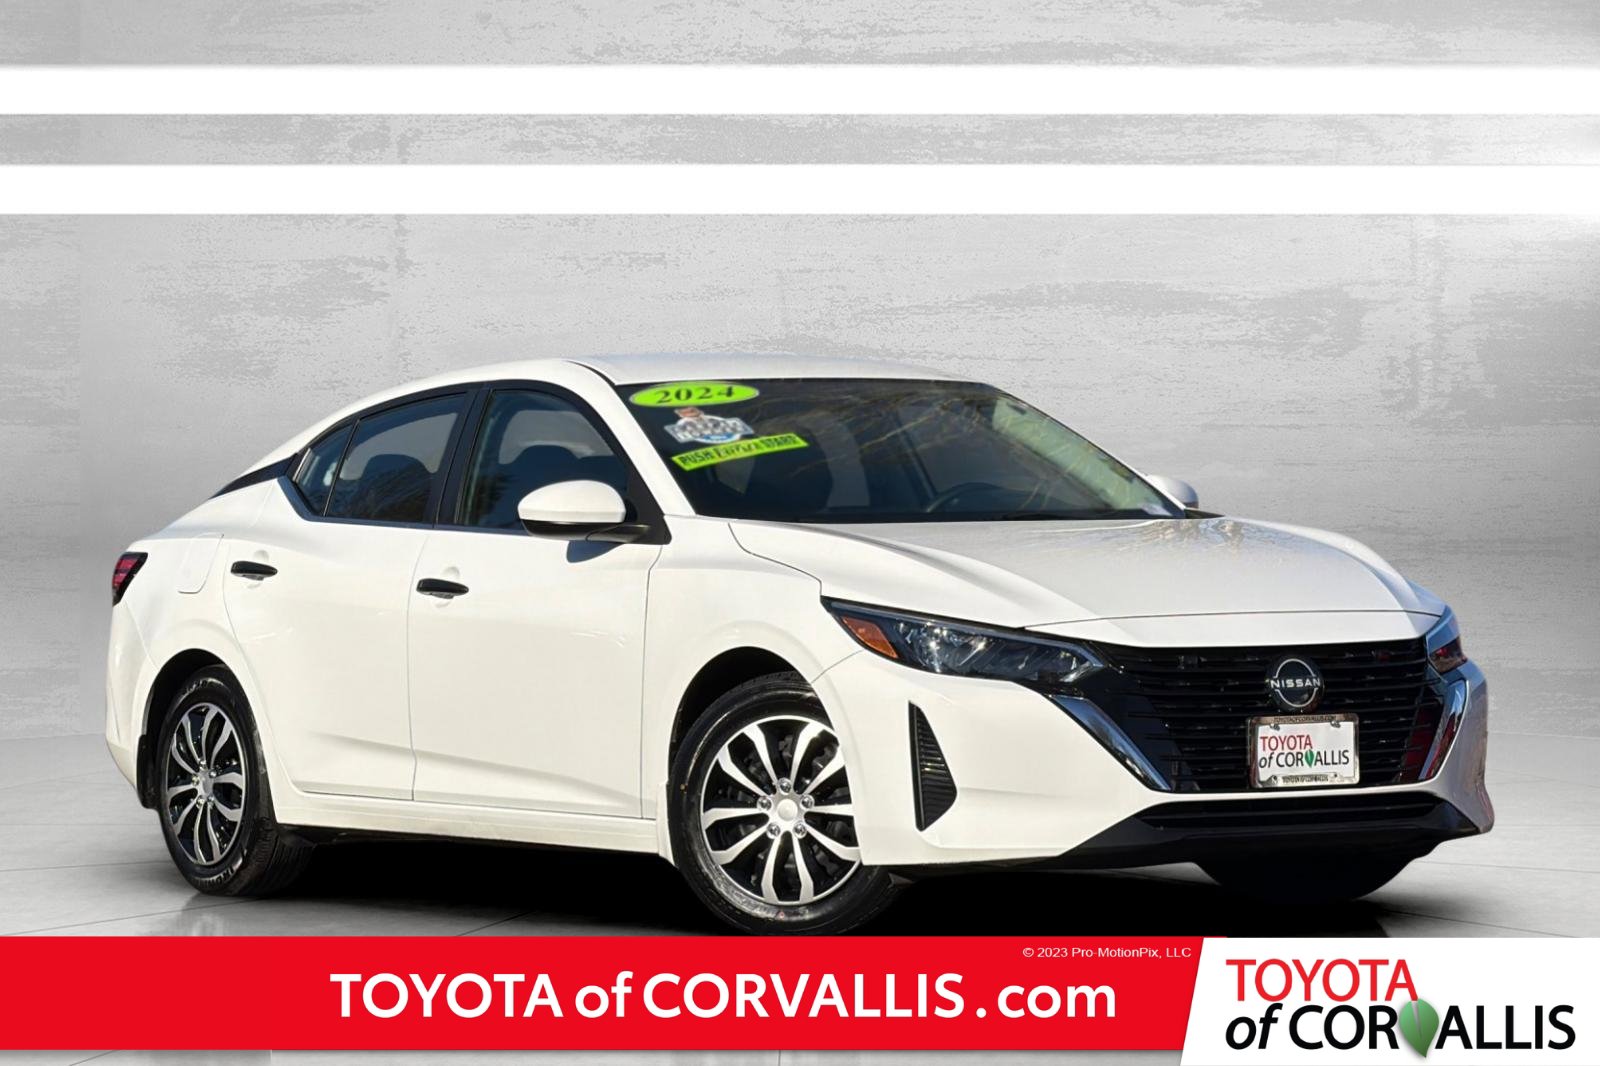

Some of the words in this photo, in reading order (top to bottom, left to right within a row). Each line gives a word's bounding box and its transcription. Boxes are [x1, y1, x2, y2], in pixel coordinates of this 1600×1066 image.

[655, 386, 735, 404] 2024
[679, 452, 713, 465] PUSH
[761, 435, 797, 448] START
[1271, 678, 1320, 688] NISSAN
[1260, 734, 1313, 752] TOYOTA
[1259, 752, 1274, 768] of
